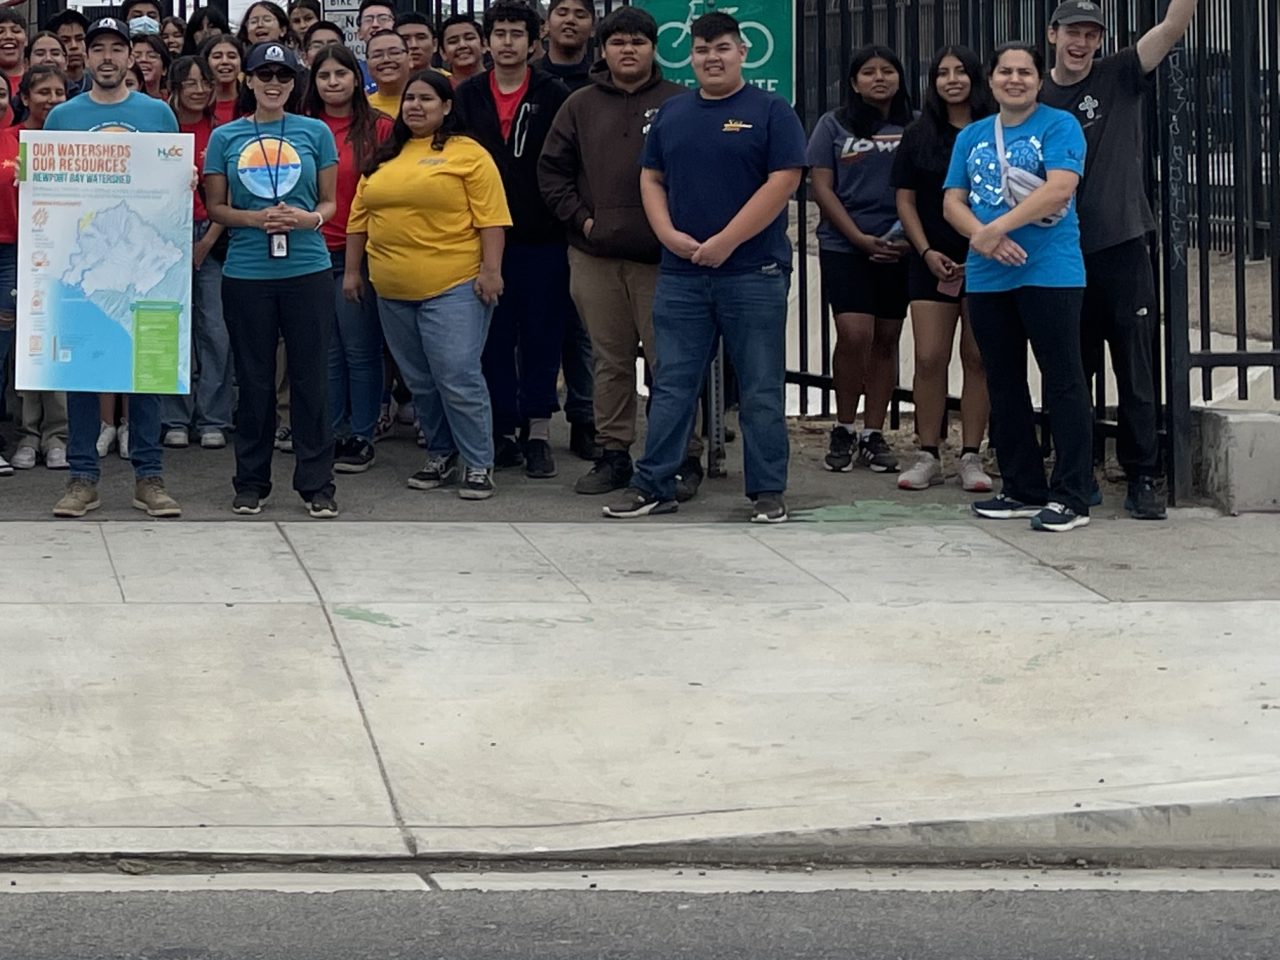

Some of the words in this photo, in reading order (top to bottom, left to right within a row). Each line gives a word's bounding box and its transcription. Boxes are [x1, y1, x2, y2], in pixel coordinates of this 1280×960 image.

[32, 143, 55, 157] OUR
[57, 143, 131, 159] WATERSHEDS
[32, 157, 56, 172] OUR
[32, 172, 68, 183] NEWPORT
[70, 174, 84, 184] BAY
[86, 174, 132, 185] WATERSHED
